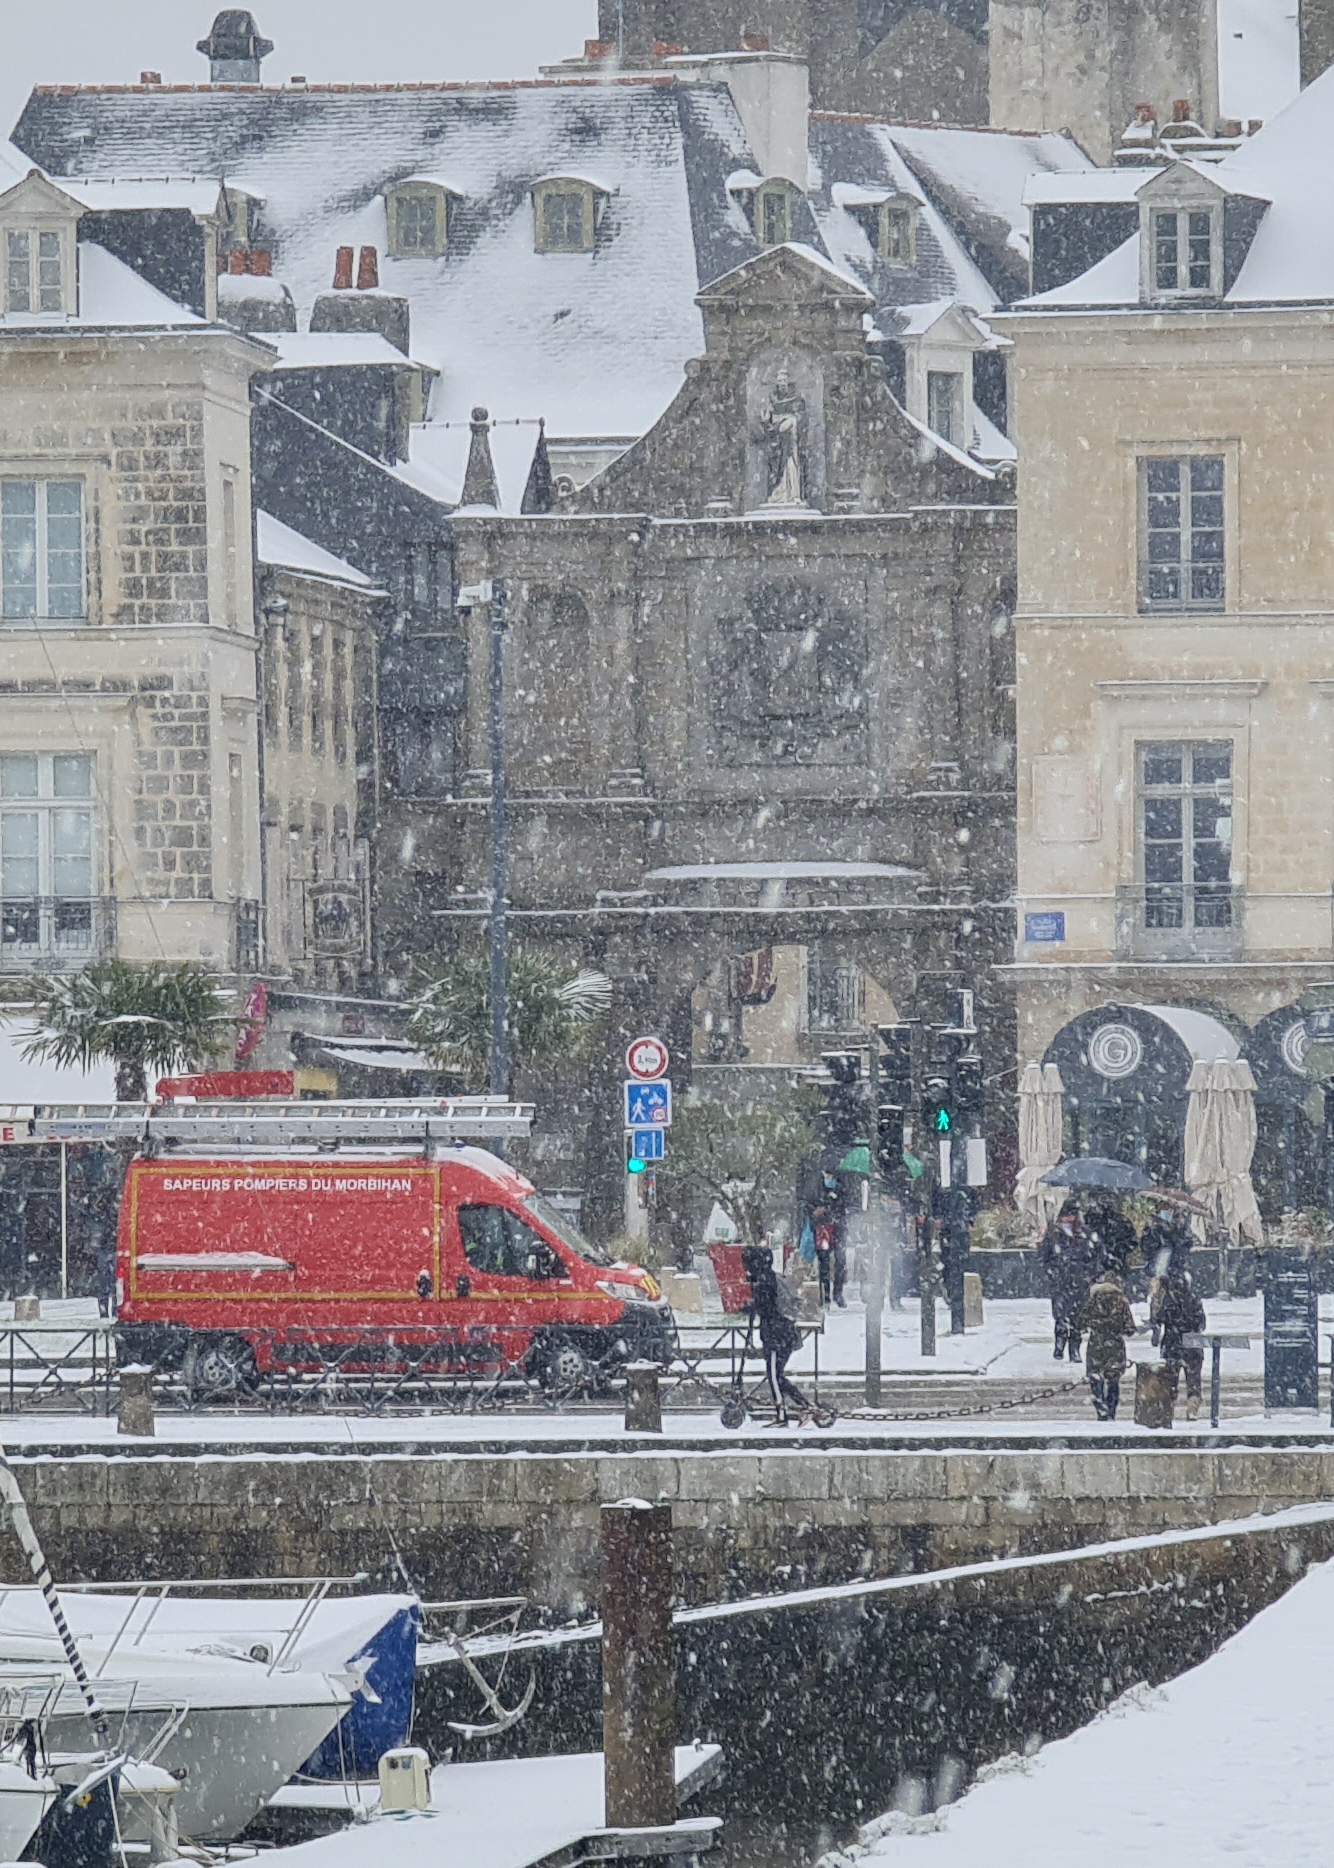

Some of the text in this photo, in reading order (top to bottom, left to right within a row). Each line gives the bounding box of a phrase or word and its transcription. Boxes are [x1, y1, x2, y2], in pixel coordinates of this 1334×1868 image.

[163, 1178, 412, 1191] SAPEURS POMPIERS DU MORBIHAN
